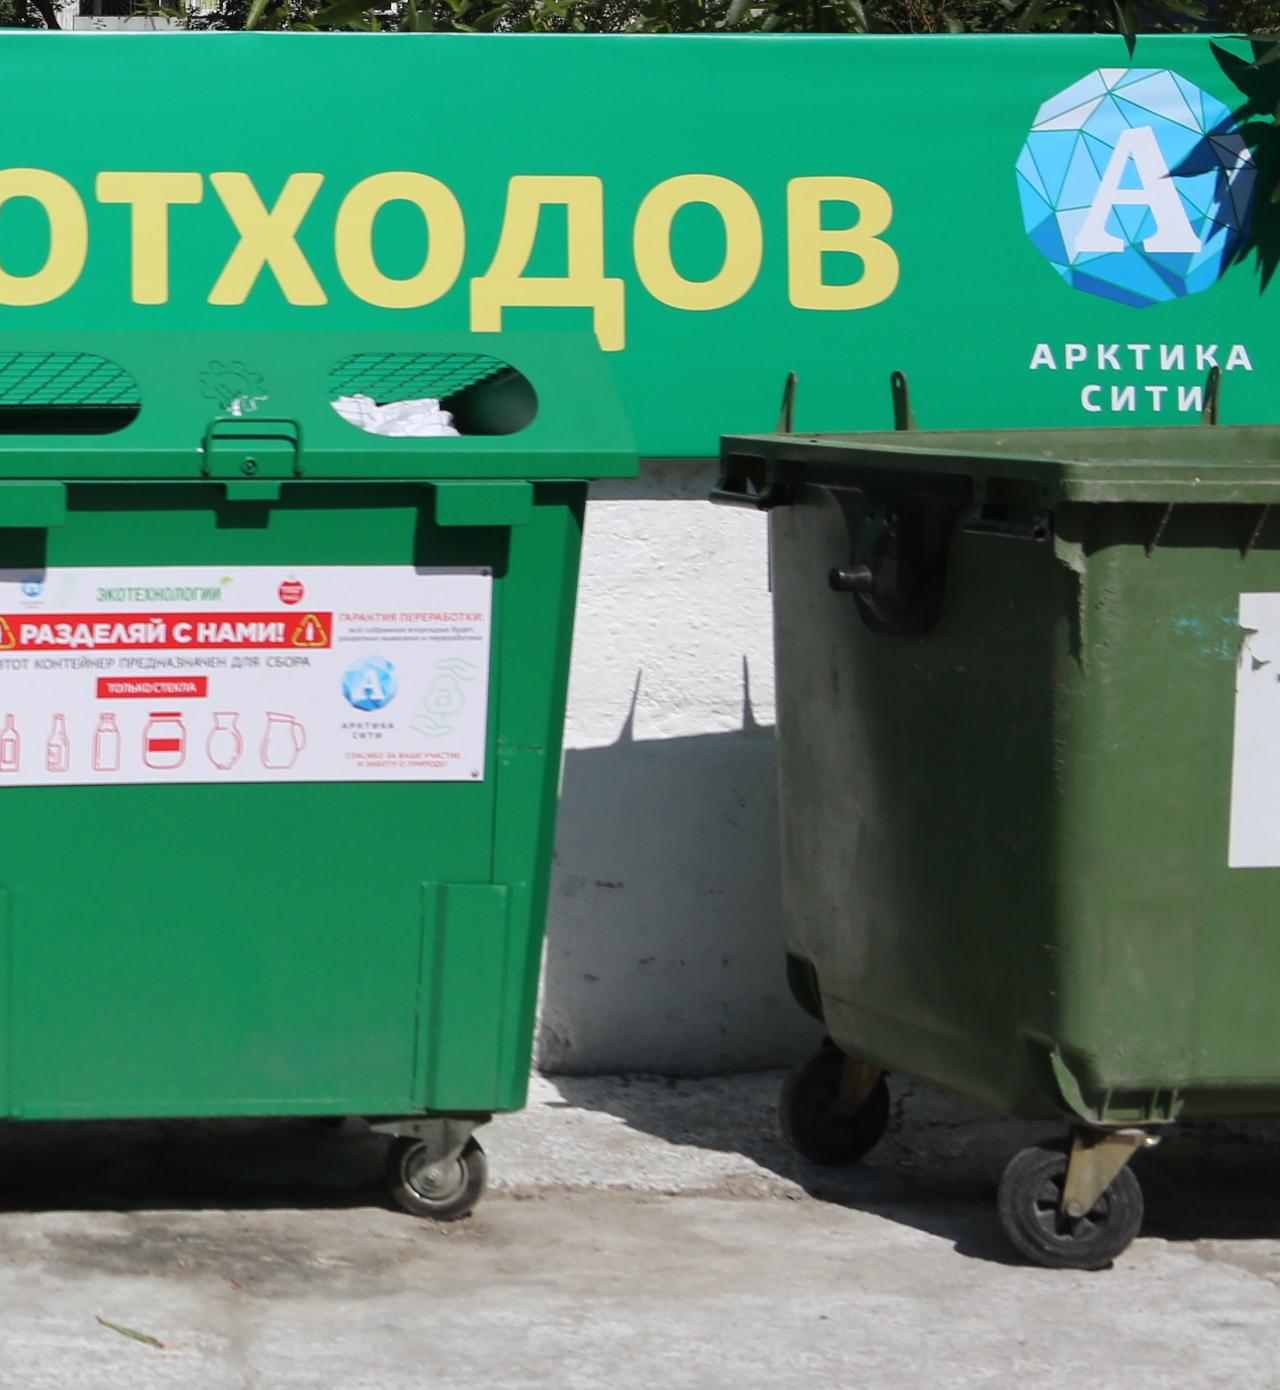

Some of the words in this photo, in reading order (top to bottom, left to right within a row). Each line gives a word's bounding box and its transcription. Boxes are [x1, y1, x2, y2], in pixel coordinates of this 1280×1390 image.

[1029, 343, 1253, 371] АРКТИКА
[1080, 384, 1202, 412] СИТИ
[97, 588, 221, 602] ЭКОТЕХНОЛОГИИ
[20, 618, 166, 647] РАЗДЕЛЯЙ
[172, 622, 192, 643] С
[198, 622, 285, 643] НАМИ!
[35, 656, 115, 670] КОНТЕЙНЕР
[119, 657, 227, 669] ПРЕДНАЗНАЧЕН
[231, 657, 259, 669] ДЛЯ
[266, 657, 311, 668] СБОРА
